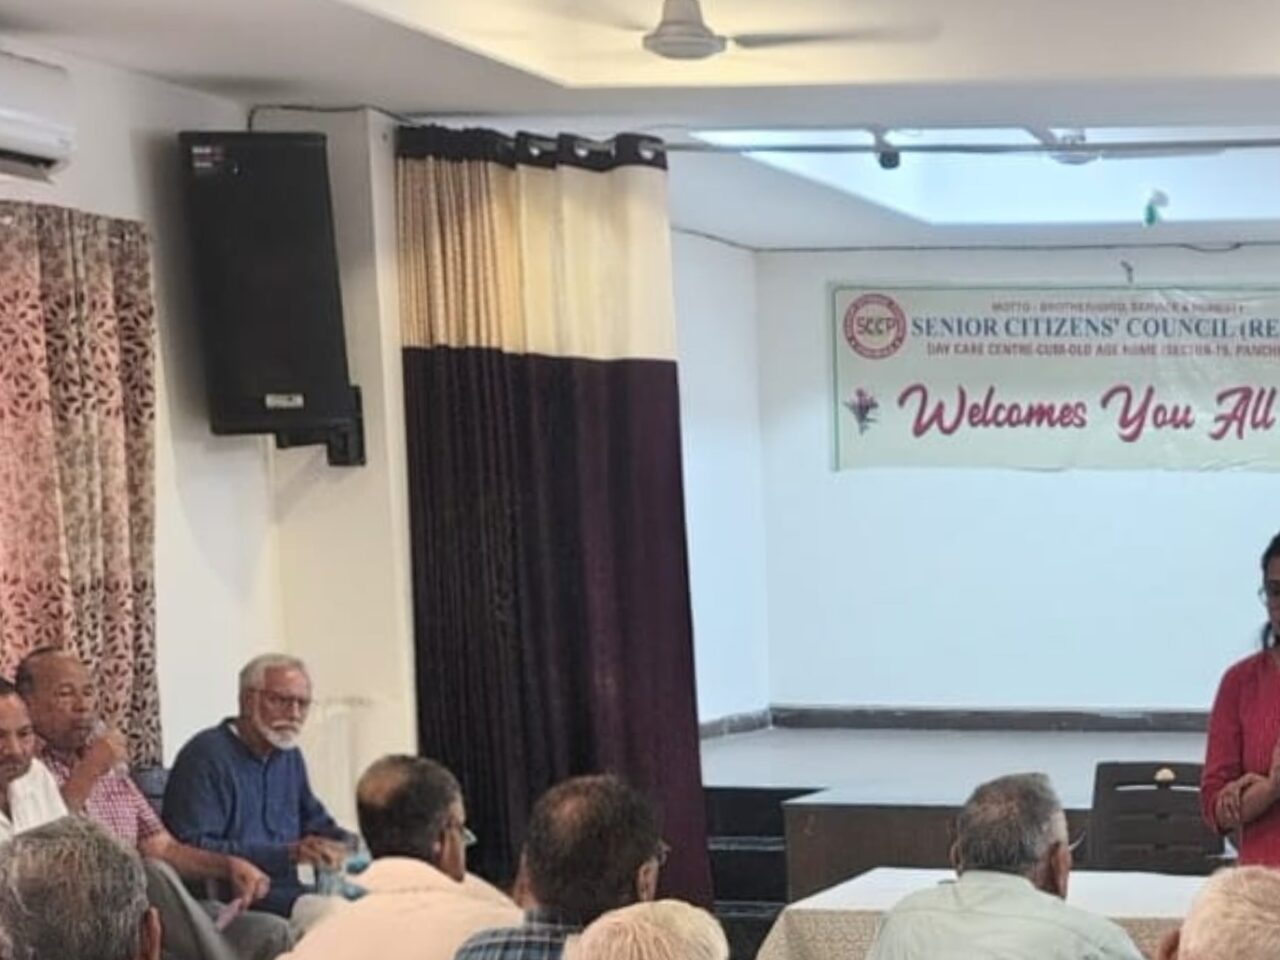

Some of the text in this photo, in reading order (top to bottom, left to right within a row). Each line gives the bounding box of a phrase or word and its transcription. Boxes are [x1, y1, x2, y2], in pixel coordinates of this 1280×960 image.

[856, 316, 896, 336] SCCP
[911, 316, 998, 337] SENIOR
[1127, 317, 1235, 338] COUNCIL
[954, 344, 983, 357] CARE
[897, 383, 1278, 442] Welcomes You All
